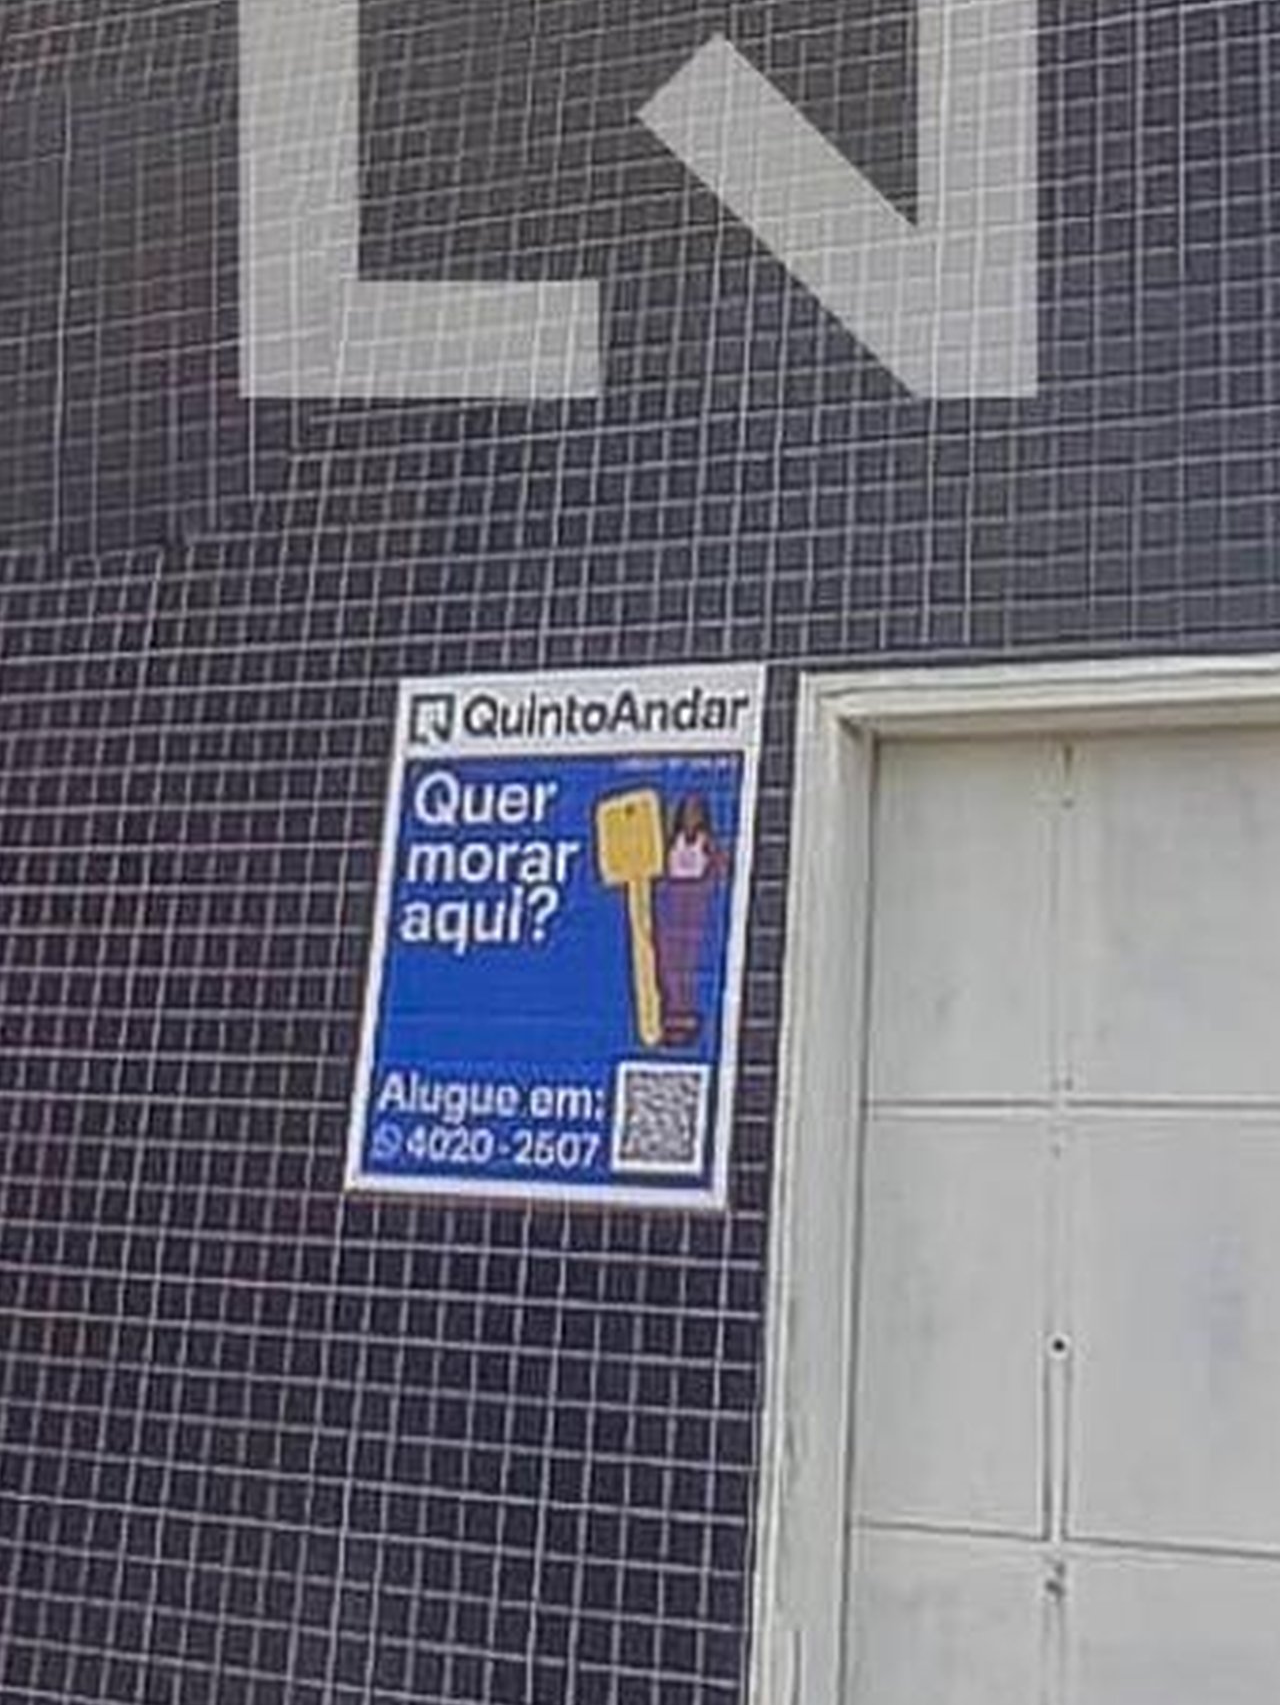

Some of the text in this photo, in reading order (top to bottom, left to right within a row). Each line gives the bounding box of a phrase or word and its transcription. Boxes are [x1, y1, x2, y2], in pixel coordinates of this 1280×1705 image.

[462, 685, 750, 738] QuintoAndar
[414, 770, 558, 826] Quer
[407, 841, 580, 883] morar
[399, 886, 559, 956] aqui?
[378, 1070, 604, 1124] Alugue em:
